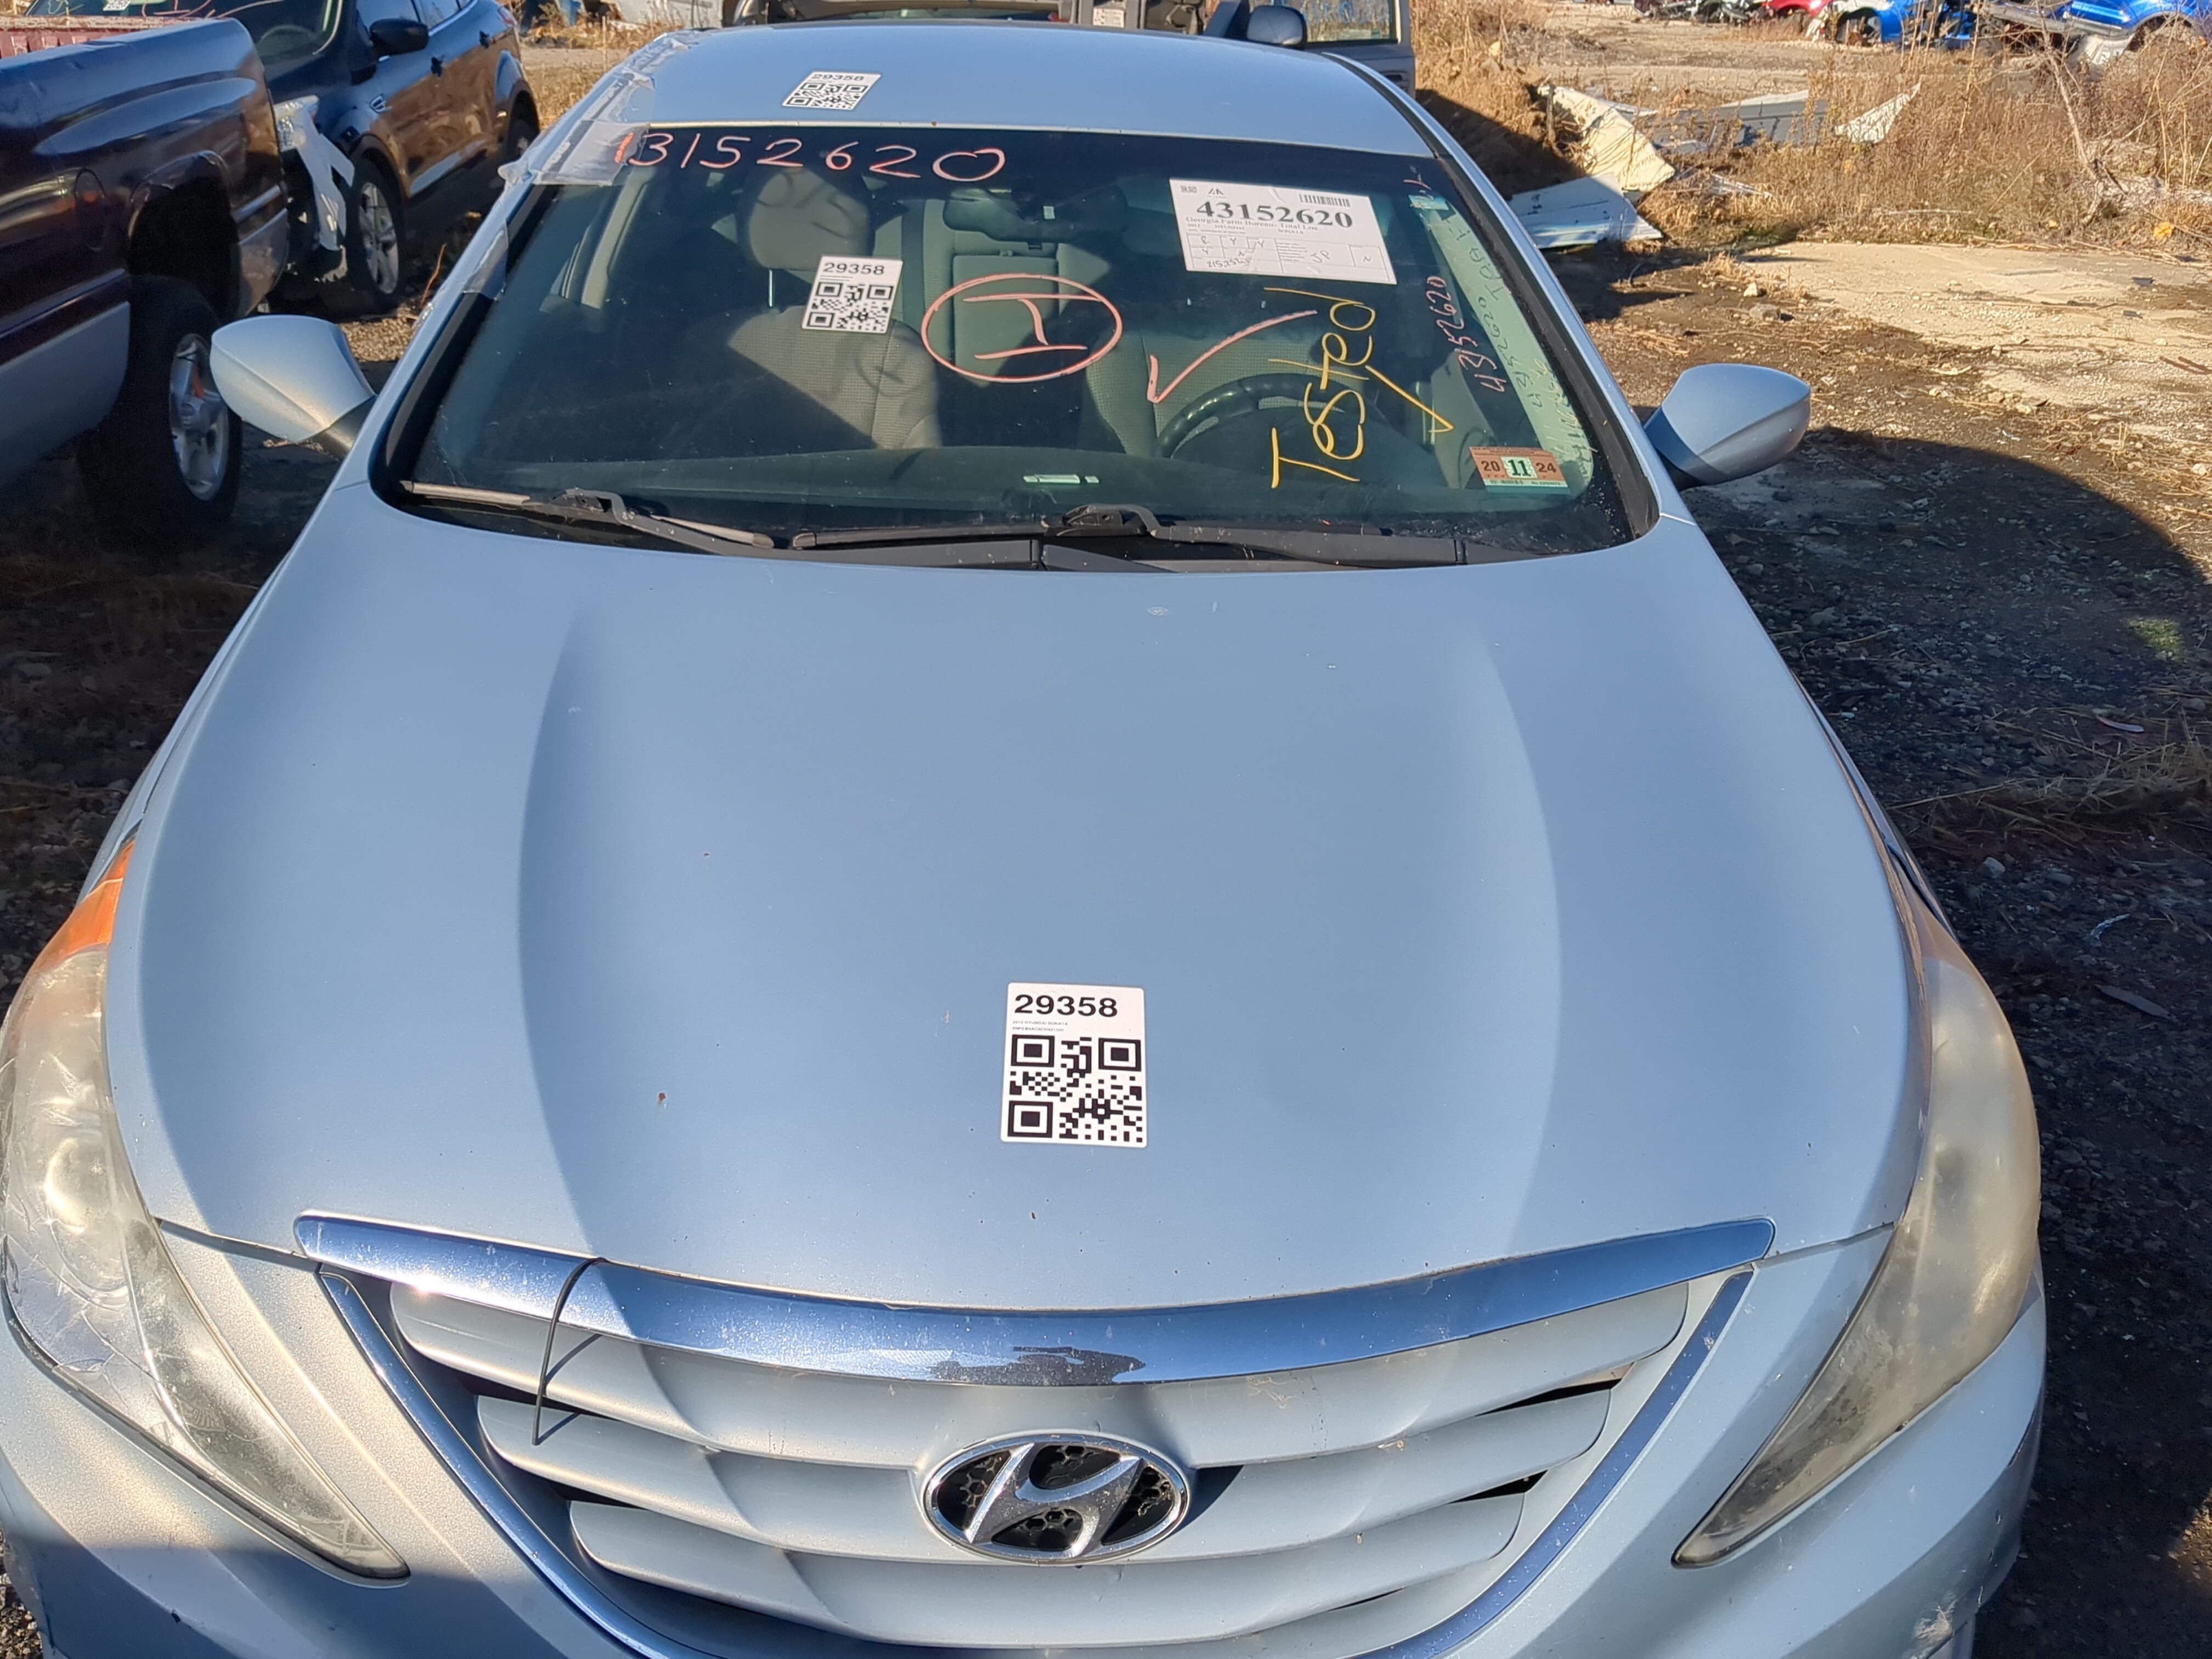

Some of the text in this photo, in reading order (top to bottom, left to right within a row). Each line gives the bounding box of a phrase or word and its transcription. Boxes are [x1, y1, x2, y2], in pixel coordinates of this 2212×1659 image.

[1197, 201, 1352, 228] 43152620
[822, 262, 885, 275] 29358
[1481, 459, 1557, 477] 20 11 24
[1014, 994, 1118, 1017] 29358
